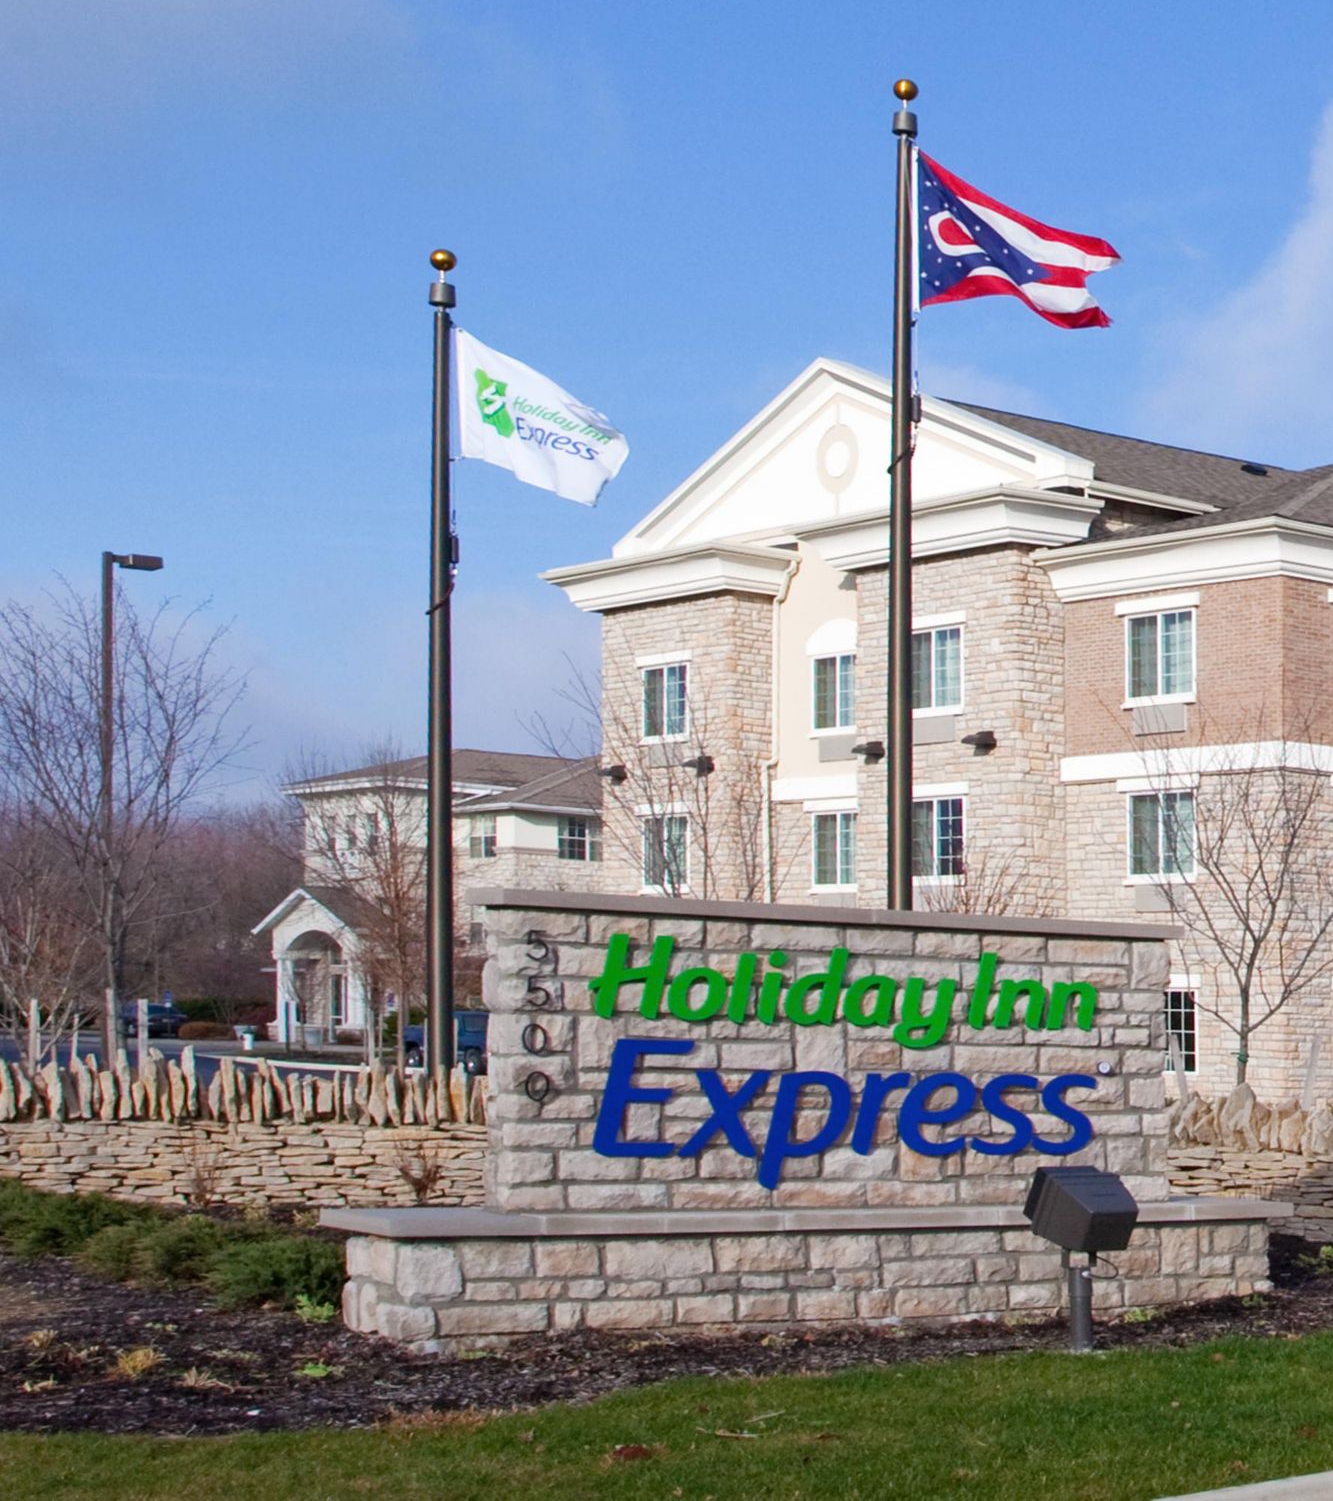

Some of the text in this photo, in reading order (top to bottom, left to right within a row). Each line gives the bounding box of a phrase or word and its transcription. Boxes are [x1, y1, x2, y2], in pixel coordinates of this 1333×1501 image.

[512, 396, 613, 445] Holiday Inn
[516, 417, 600, 461] Express
[522, 929, 550, 1102] 5500
[588, 932, 1098, 1049] Holiday Inn
[591, 1038, 1097, 1190] Express
